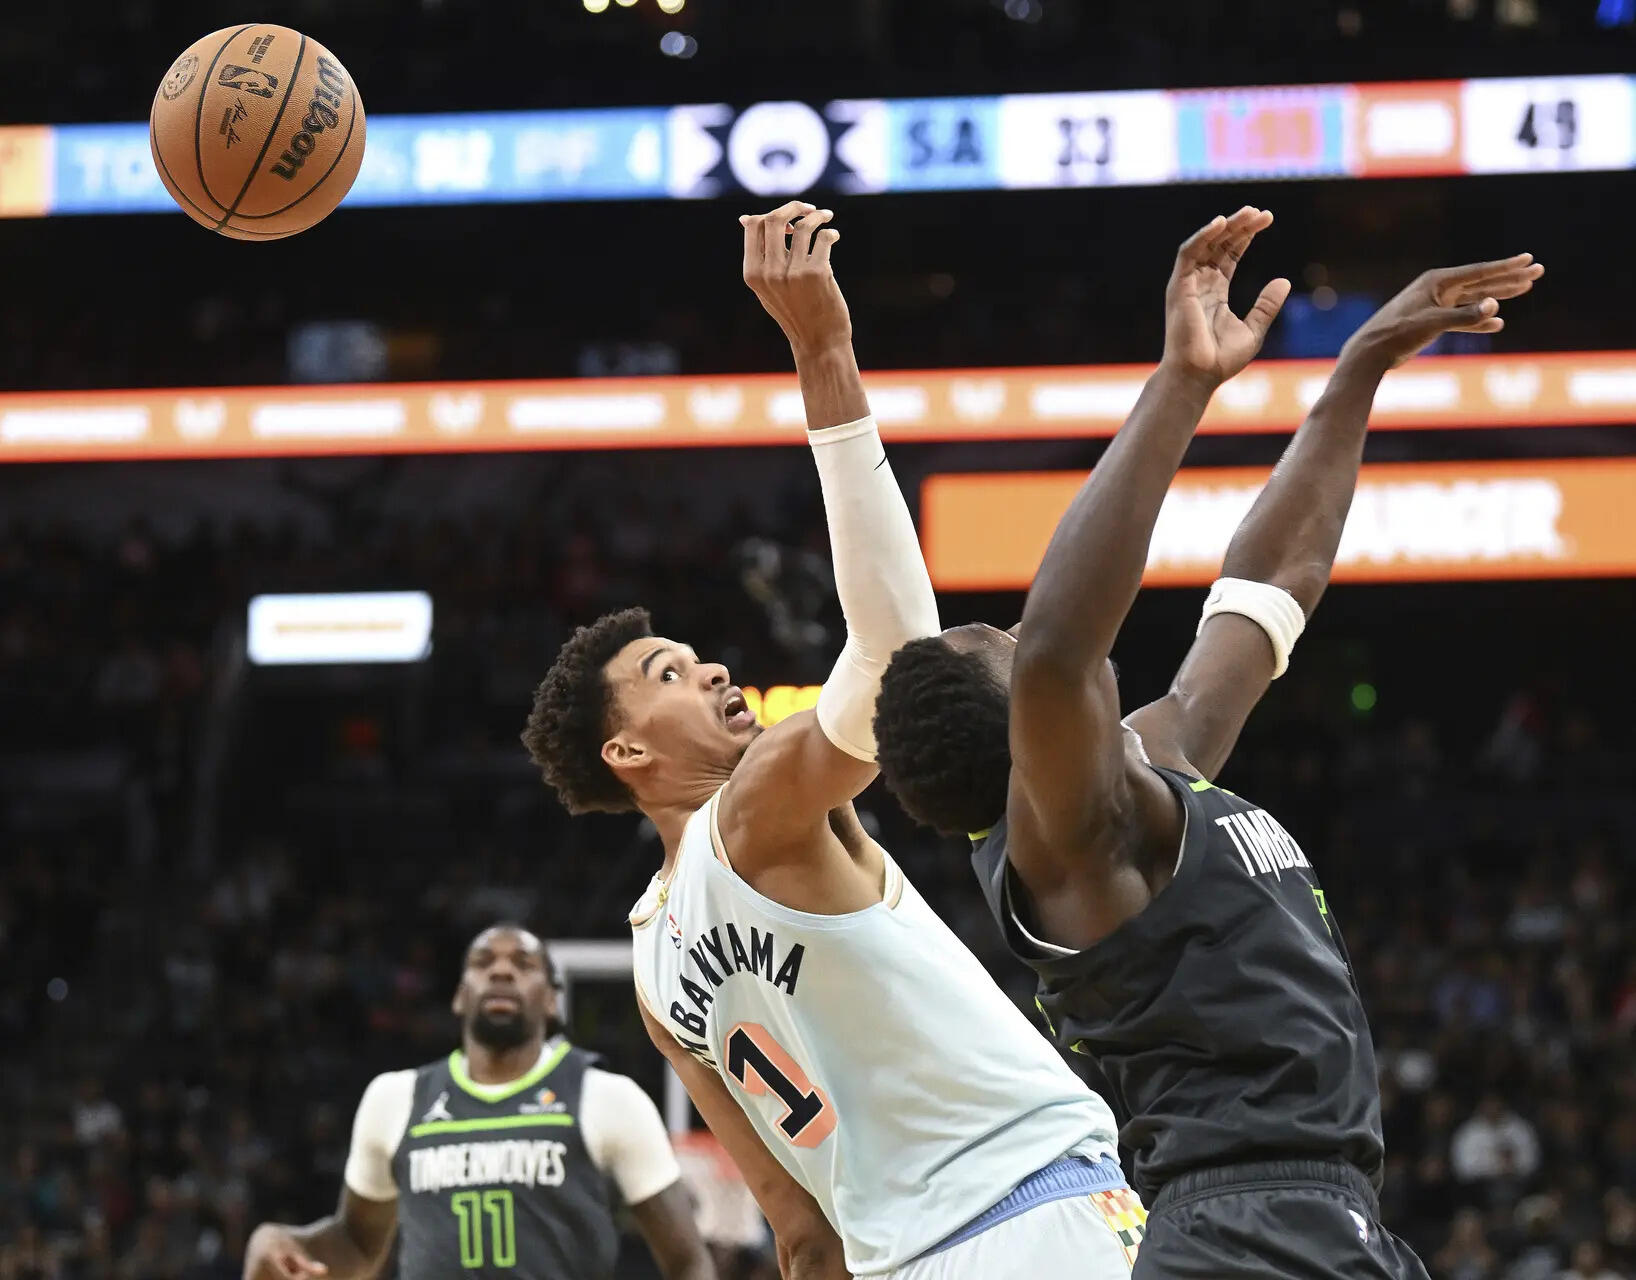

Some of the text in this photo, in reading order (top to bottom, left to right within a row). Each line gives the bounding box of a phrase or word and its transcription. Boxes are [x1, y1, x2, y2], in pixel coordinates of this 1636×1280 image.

[1516, 98, 1578, 150] 49
[725, 1023, 828, 1143] 1
[407, 1138, 568, 1194] TIMBERWOLVES
[451, 1189, 517, 1269] 11
